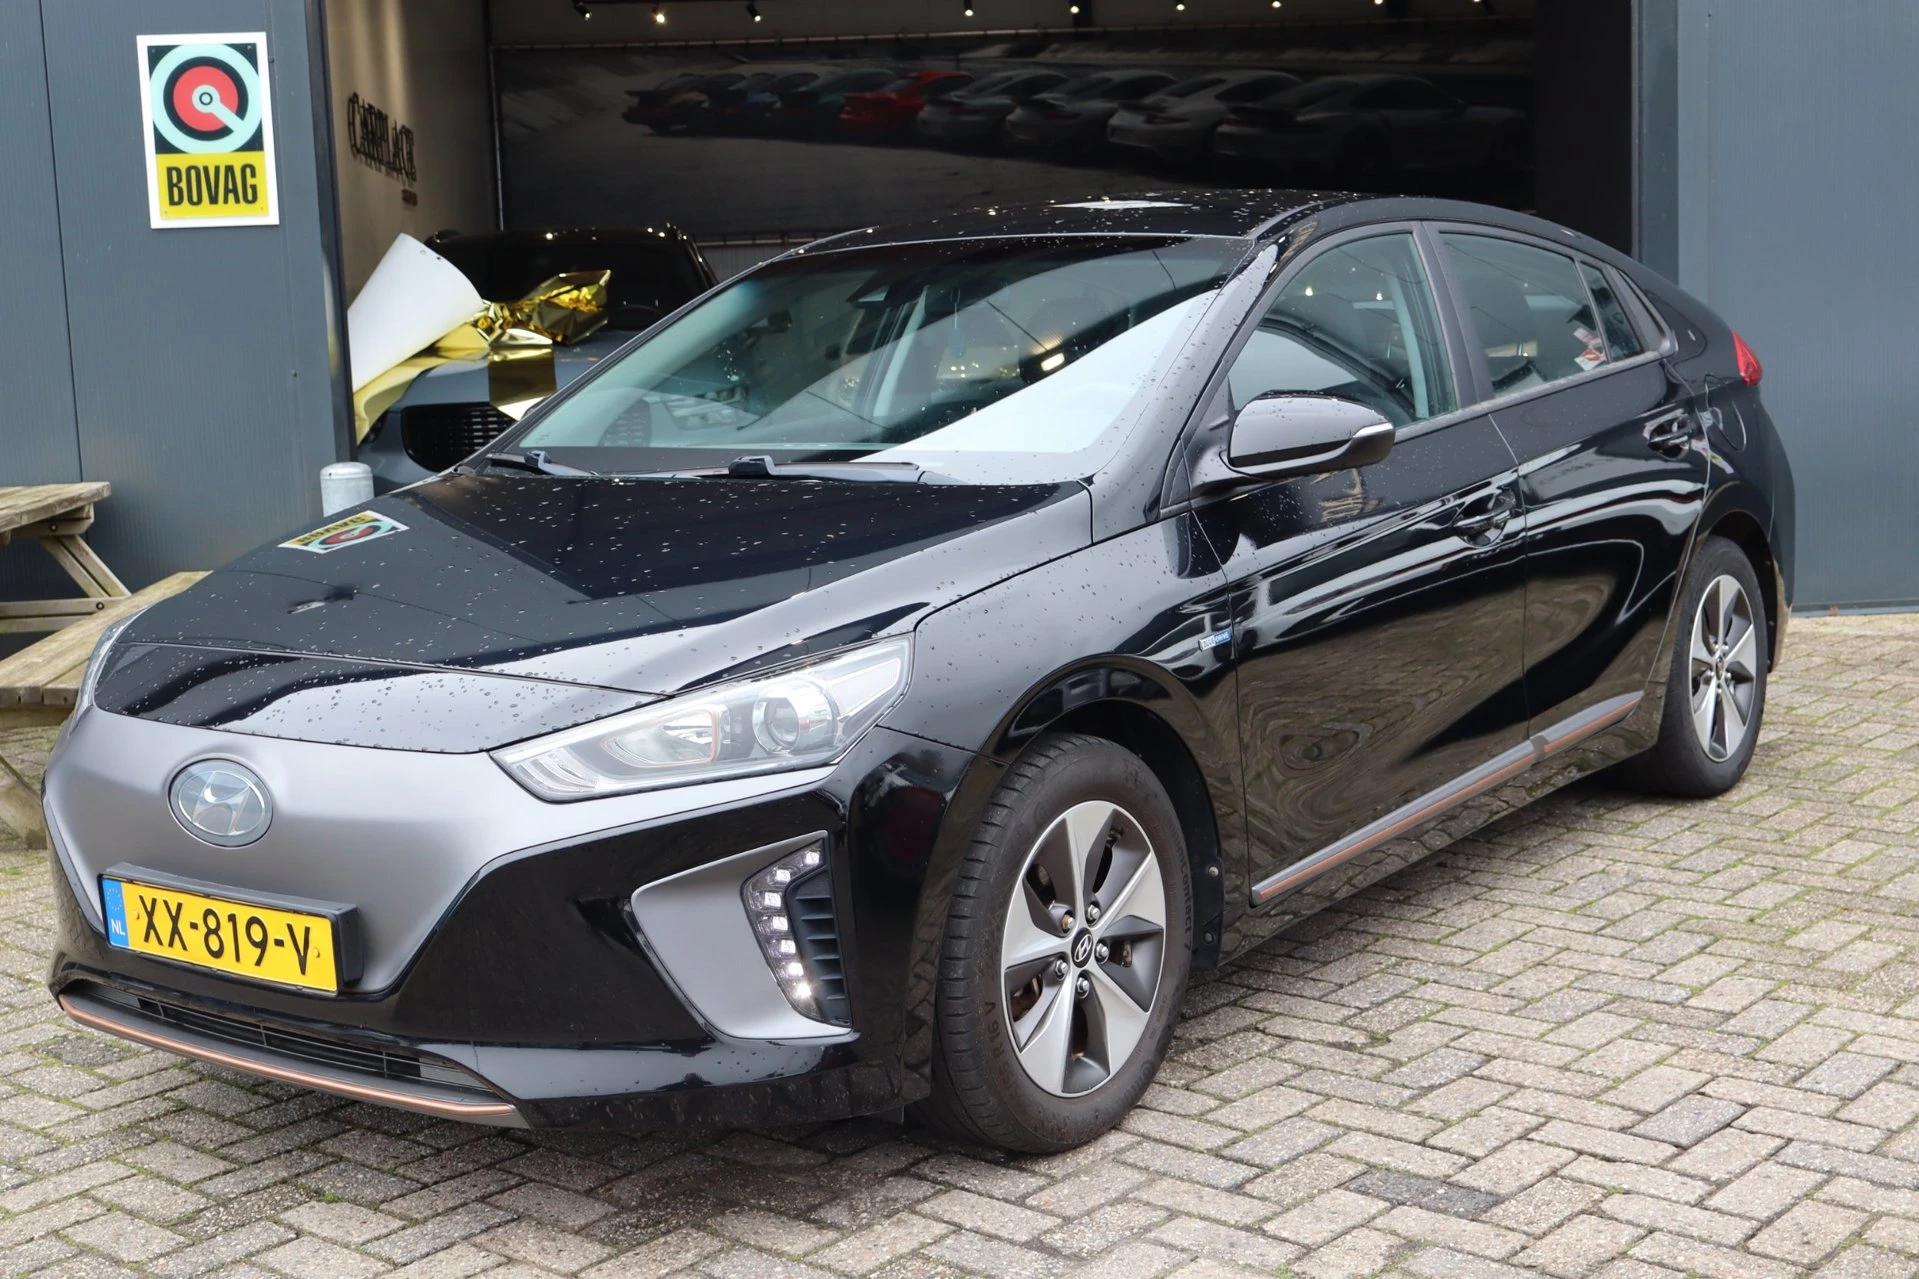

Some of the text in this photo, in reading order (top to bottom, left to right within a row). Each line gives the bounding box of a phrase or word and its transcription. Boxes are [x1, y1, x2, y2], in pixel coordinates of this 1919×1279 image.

[166, 163, 258, 206] BOVAG
[111, 920, 126, 936] NL
[138, 895, 311, 975] XX-819-V
